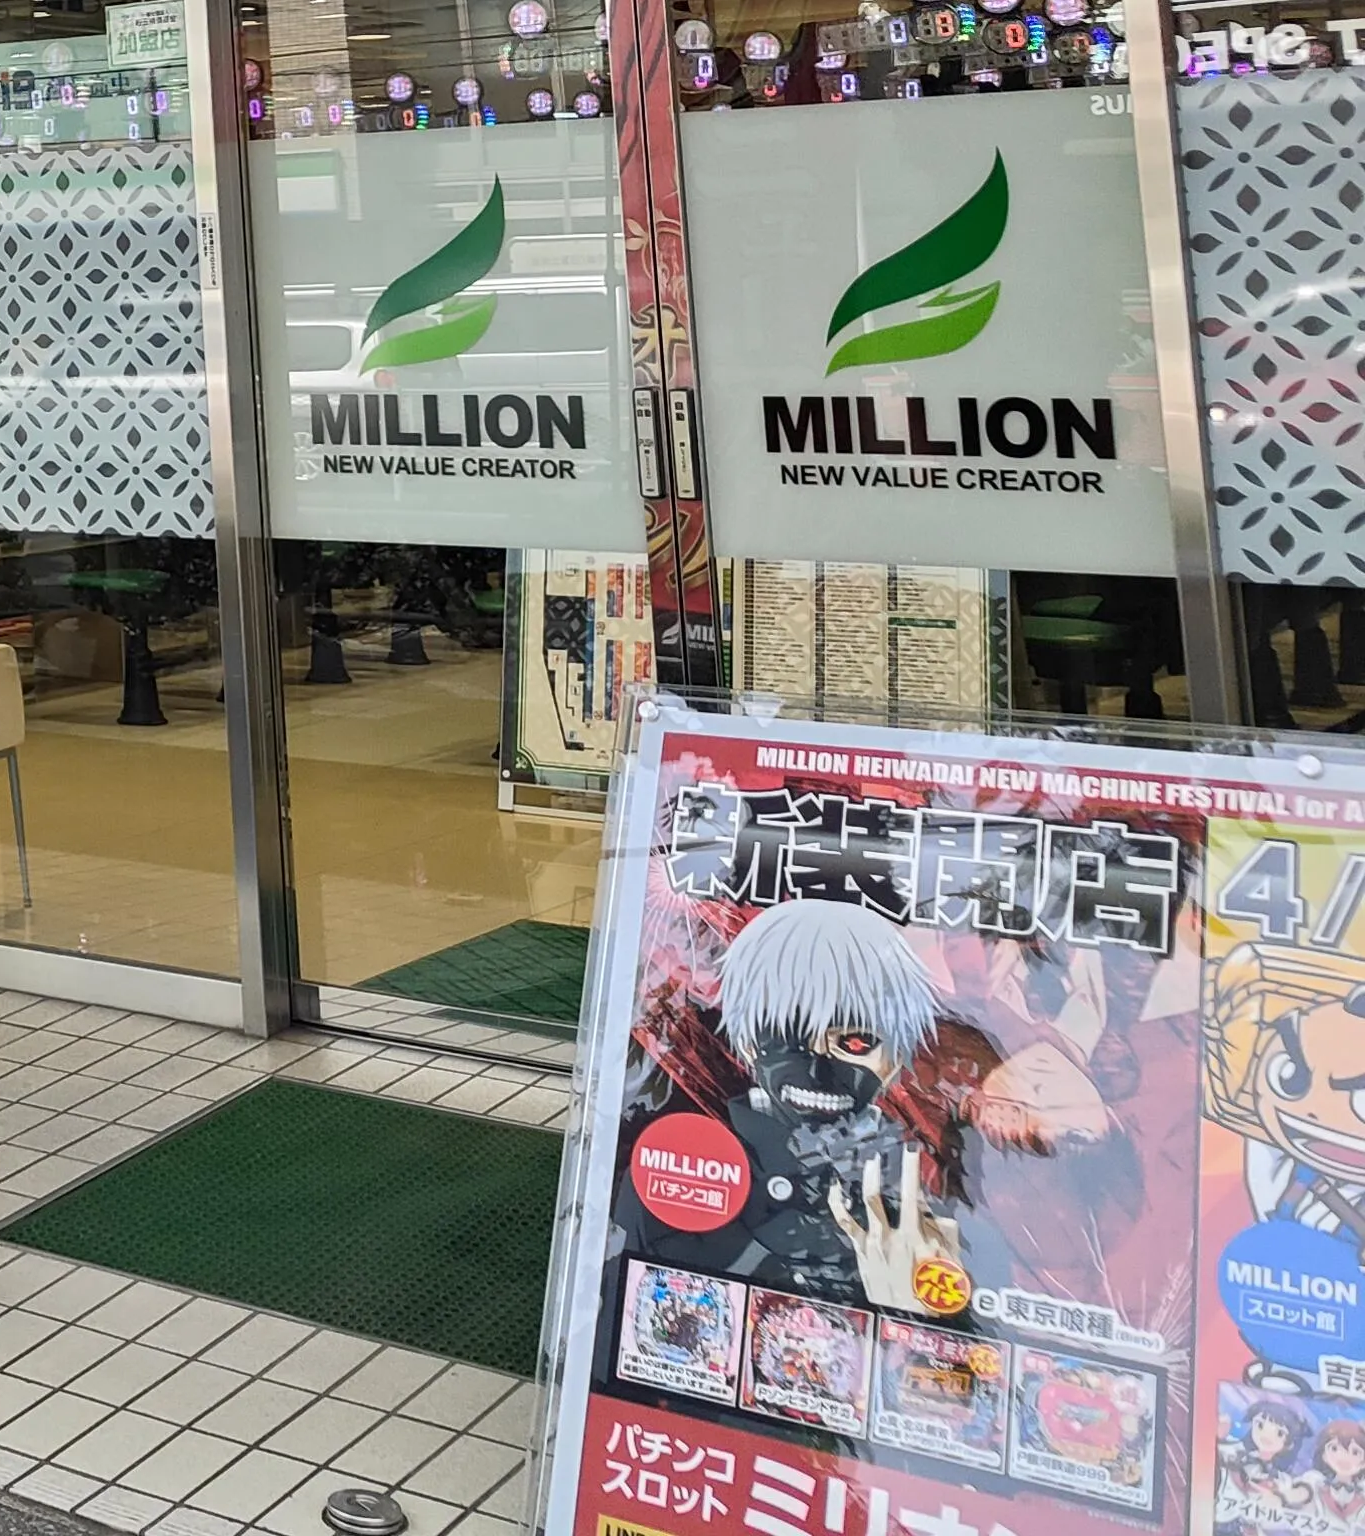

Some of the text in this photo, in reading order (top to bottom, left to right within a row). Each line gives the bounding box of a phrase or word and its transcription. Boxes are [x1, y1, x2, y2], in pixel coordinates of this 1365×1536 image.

[117, 27, 180, 56] 加盟店
[310, 394, 587, 450] MILLION
[762, 396, 1117, 460] MILLION
[324, 454, 577, 480] NEW VALUE CREATOR
[780, 464, 1106, 494] NEW VALUE CREATOR
[756, 746, 849, 776] MILLION
[853, 755, 974, 786] HEIWADAI
[978, 766, 1037, 792] NEW
[1041, 771, 1162, 805] MACHINE
[1165, 783, 1290, 816] FESTIVAL
[1295, 795, 1339, 821] for
[667, 781, 1179, 954] 新装開店
[640, 1147, 742, 1185] MILLION
[651, 1179, 724, 1208] パチンコ館
[1226, 1260, 1358, 1306] MILLION
[1247, 1297, 1336, 1333] スロット館
[604, 1421, 736, 1484] パチンコ
[601, 1458, 729, 1522] スロット
[743, 1454, 1007, 1536] ミリ
